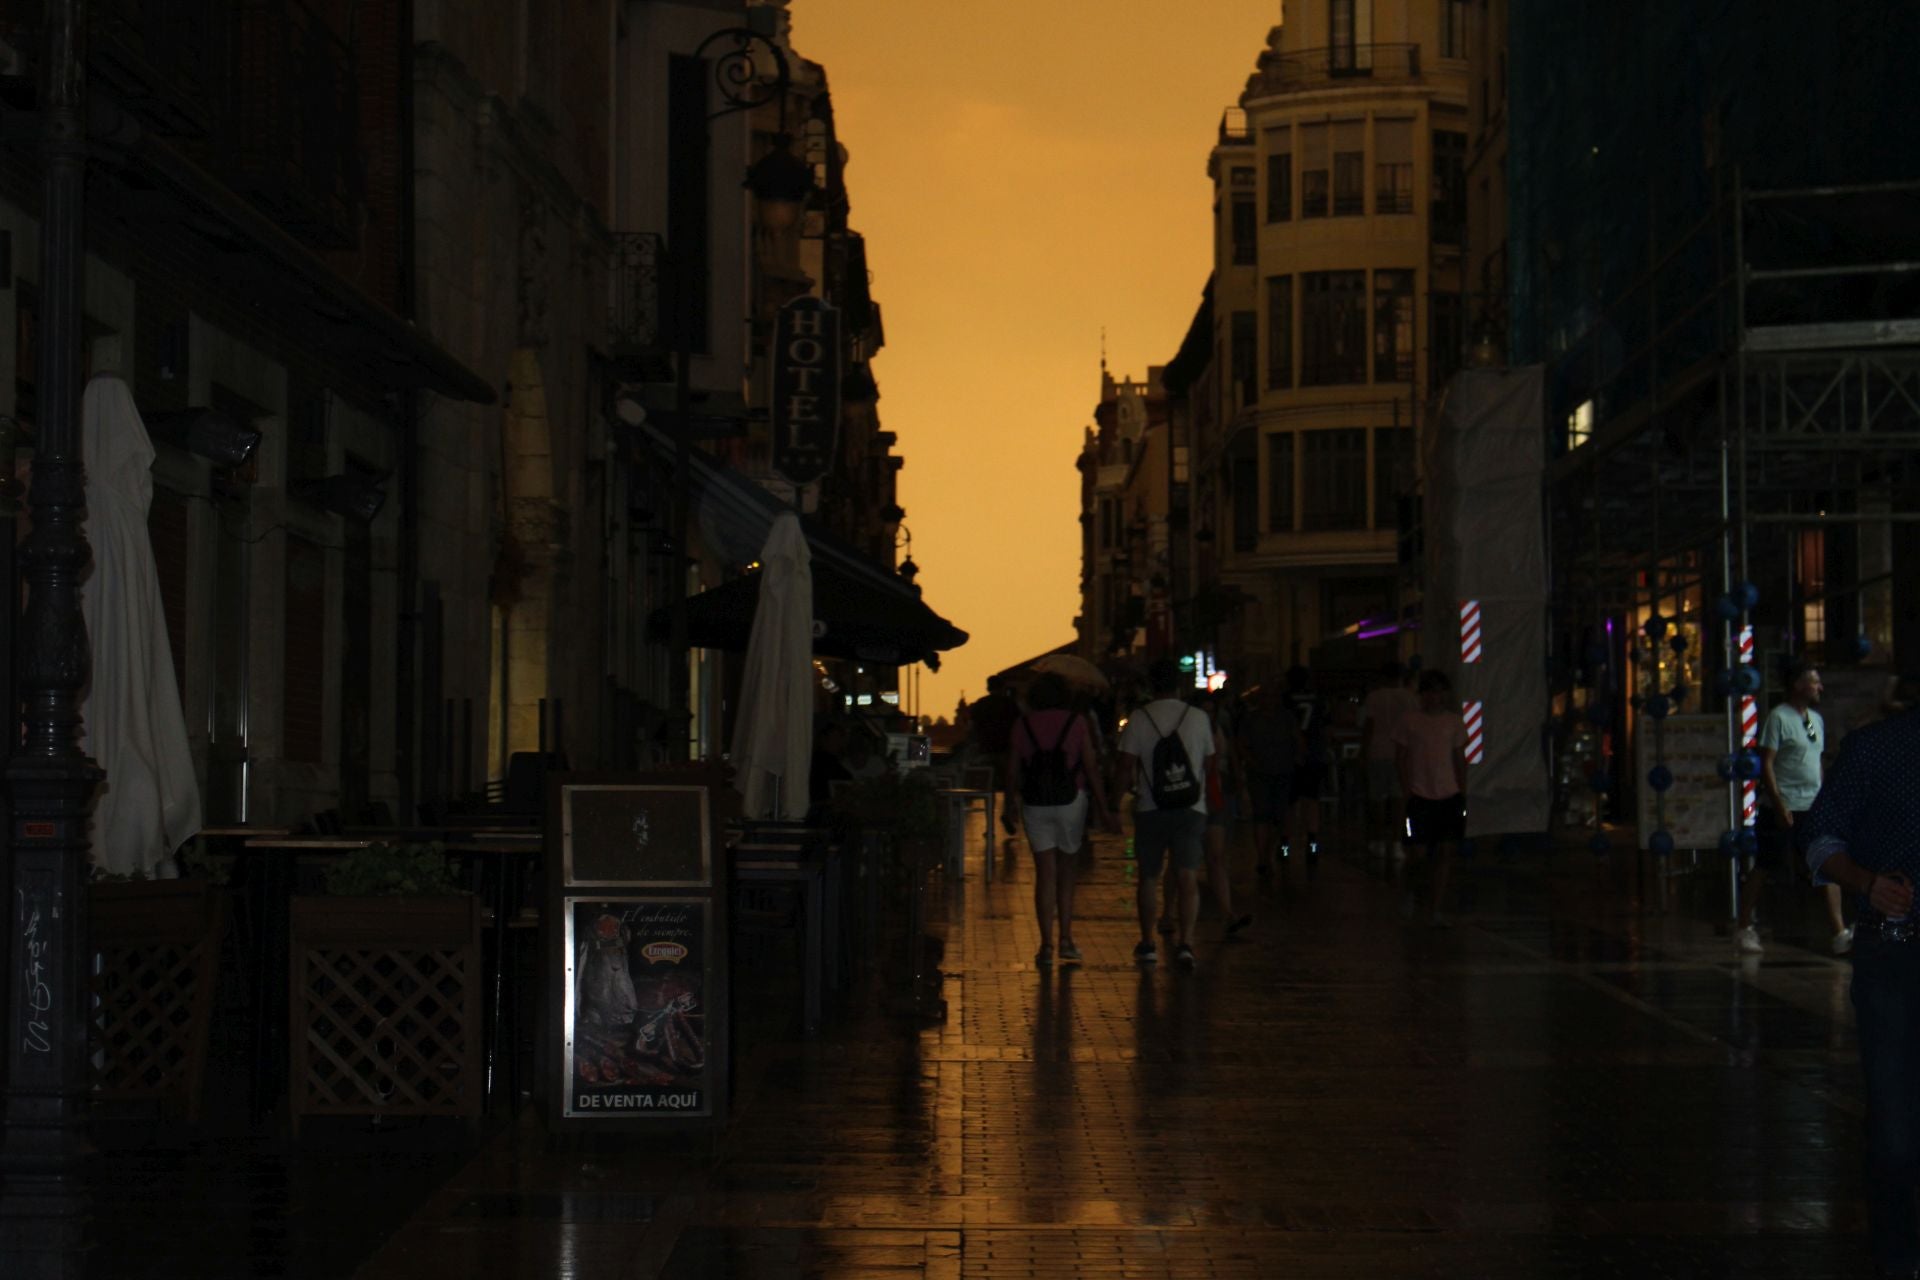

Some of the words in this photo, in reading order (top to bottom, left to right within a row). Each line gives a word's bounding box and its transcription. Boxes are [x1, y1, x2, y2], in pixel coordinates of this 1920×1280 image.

[787, 310, 824, 449] HOTEL
[622, 905, 645, 922] El
[579, 1094, 600, 1108] DE
[603, 1094, 653, 1108] VENTA
[657, 1091, 698, 1109] AQUÍ
